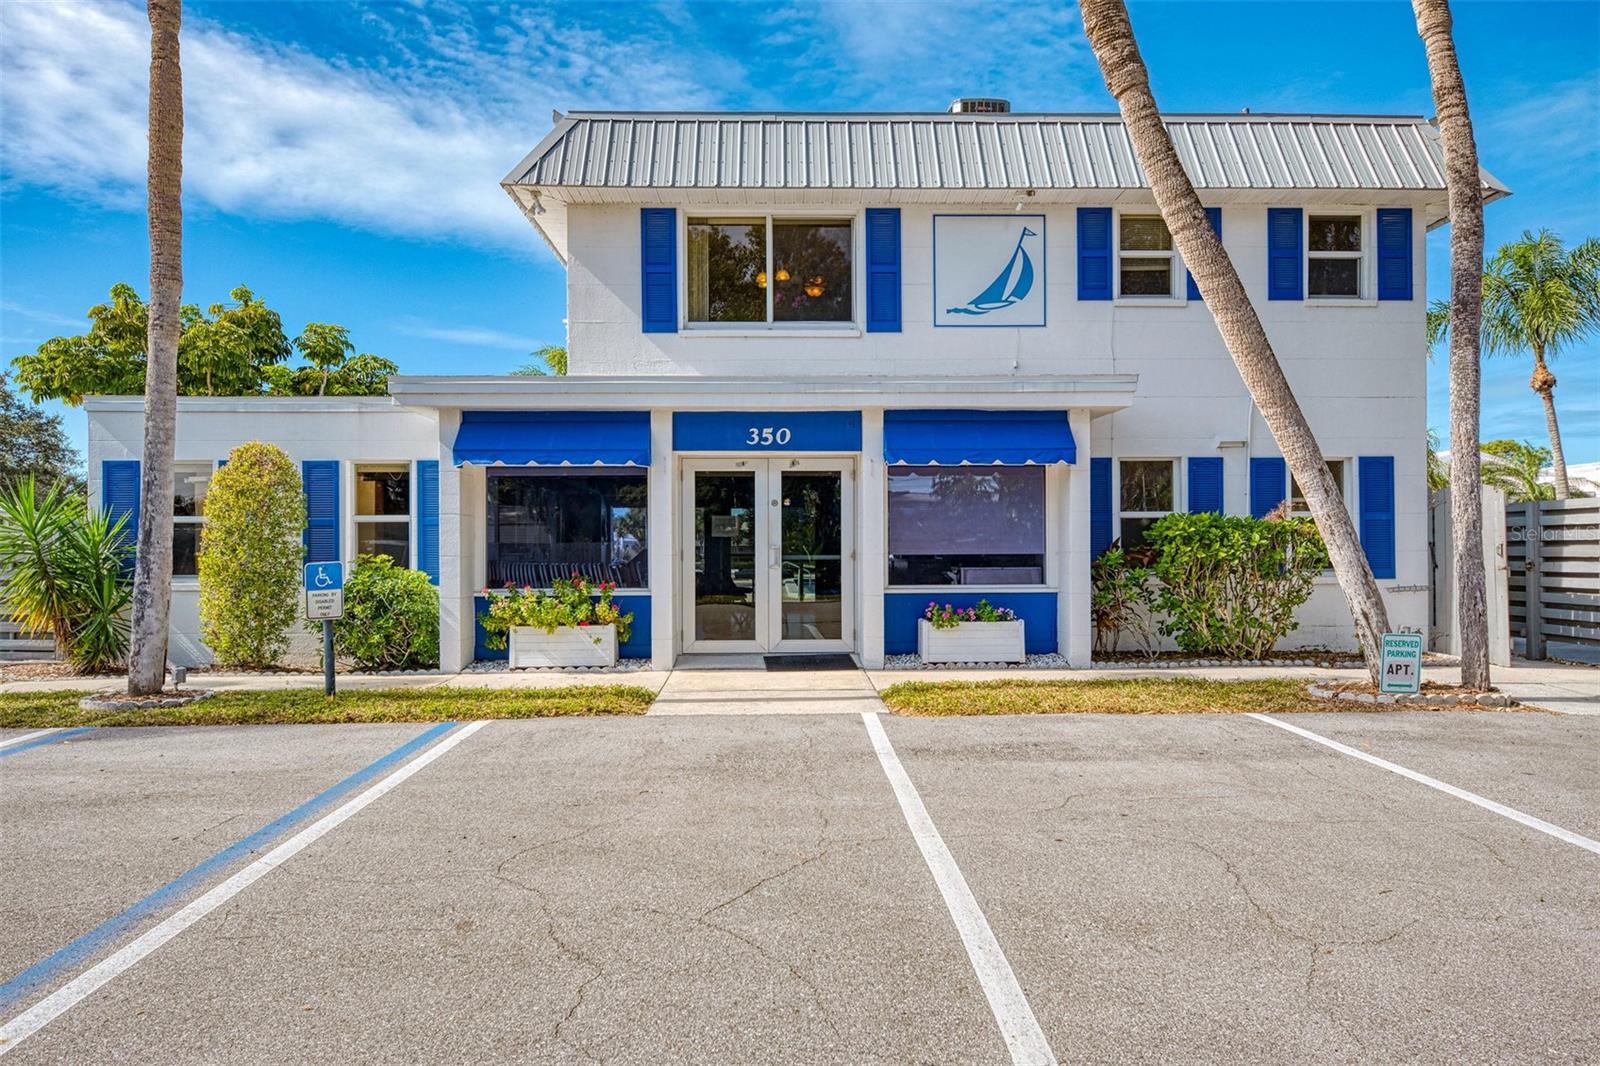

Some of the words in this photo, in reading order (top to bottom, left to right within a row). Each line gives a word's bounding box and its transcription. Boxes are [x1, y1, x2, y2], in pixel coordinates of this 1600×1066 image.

[746, 427, 791, 445] 350
[1385, 640, 1419, 648] RESERVED
[1387, 650, 1416, 658] PARKING
[1387, 664, 1414, 675] APT.
